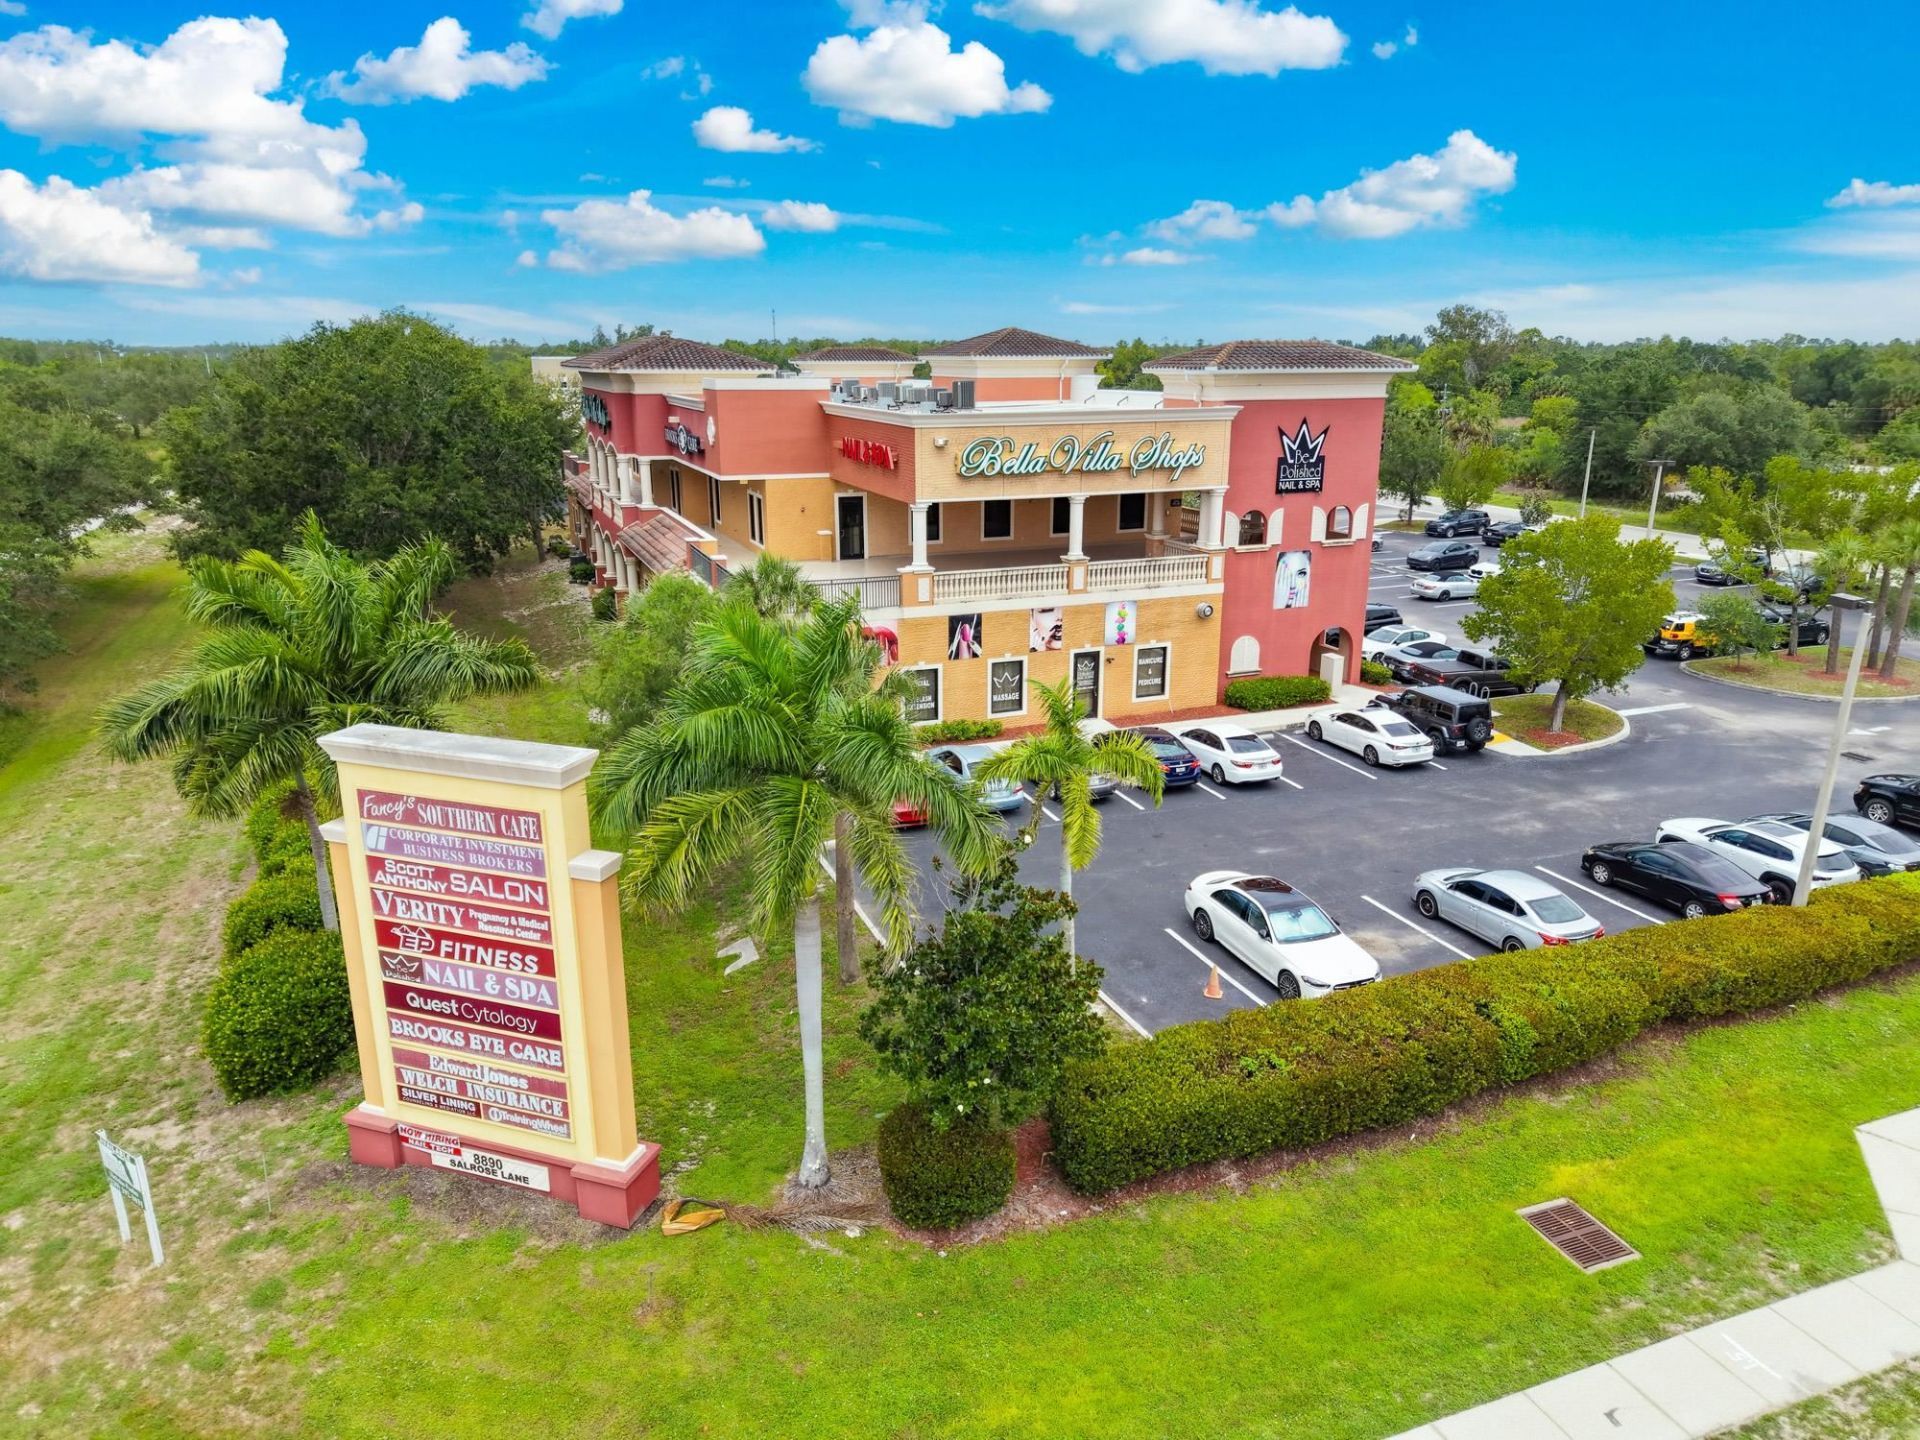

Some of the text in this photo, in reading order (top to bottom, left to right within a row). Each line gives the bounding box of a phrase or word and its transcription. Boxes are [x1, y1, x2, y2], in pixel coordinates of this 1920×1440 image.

[960, 431, 1206, 482] Bella Villa Shops
[1295, 450, 1310, 464] Be
[1280, 463, 1321, 479] Polished
[1279, 480, 1321, 490] NAIL & SPA
[992, 691, 1020, 702] MASSAGE
[363, 795, 539, 840] Fancy's SOUTHERN CAFE
[389, 828, 544, 860] CORPORATE INVESTMENT
[385, 859, 435, 879] SCOTT
[403, 843, 533, 873] BUSINESS BROKERS
[374, 871, 544, 906] ANTHONY SALON
[373, 889, 465, 928] VERITY
[468, 908, 549, 931] Pregnancy & Medical
[515, 928, 541, 940] Center
[440, 940, 539, 974] FITNESS
[424, 962, 554, 1006] NAIL & SPA
[406, 992, 537, 1034] Quest Cytology
[390, 1017, 563, 1068] BROOKS EYE CARE
[400, 1067, 564, 1118] WELCH INSURANCE
[401, 1087, 476, 1112] SILVER LINING
[400, 1126, 459, 1146] NOW HIRING
[431, 1144, 454, 1154] TECH
[449, 1159, 530, 1185] SALROSE LANE
[473, 1153, 503, 1171] 8890
